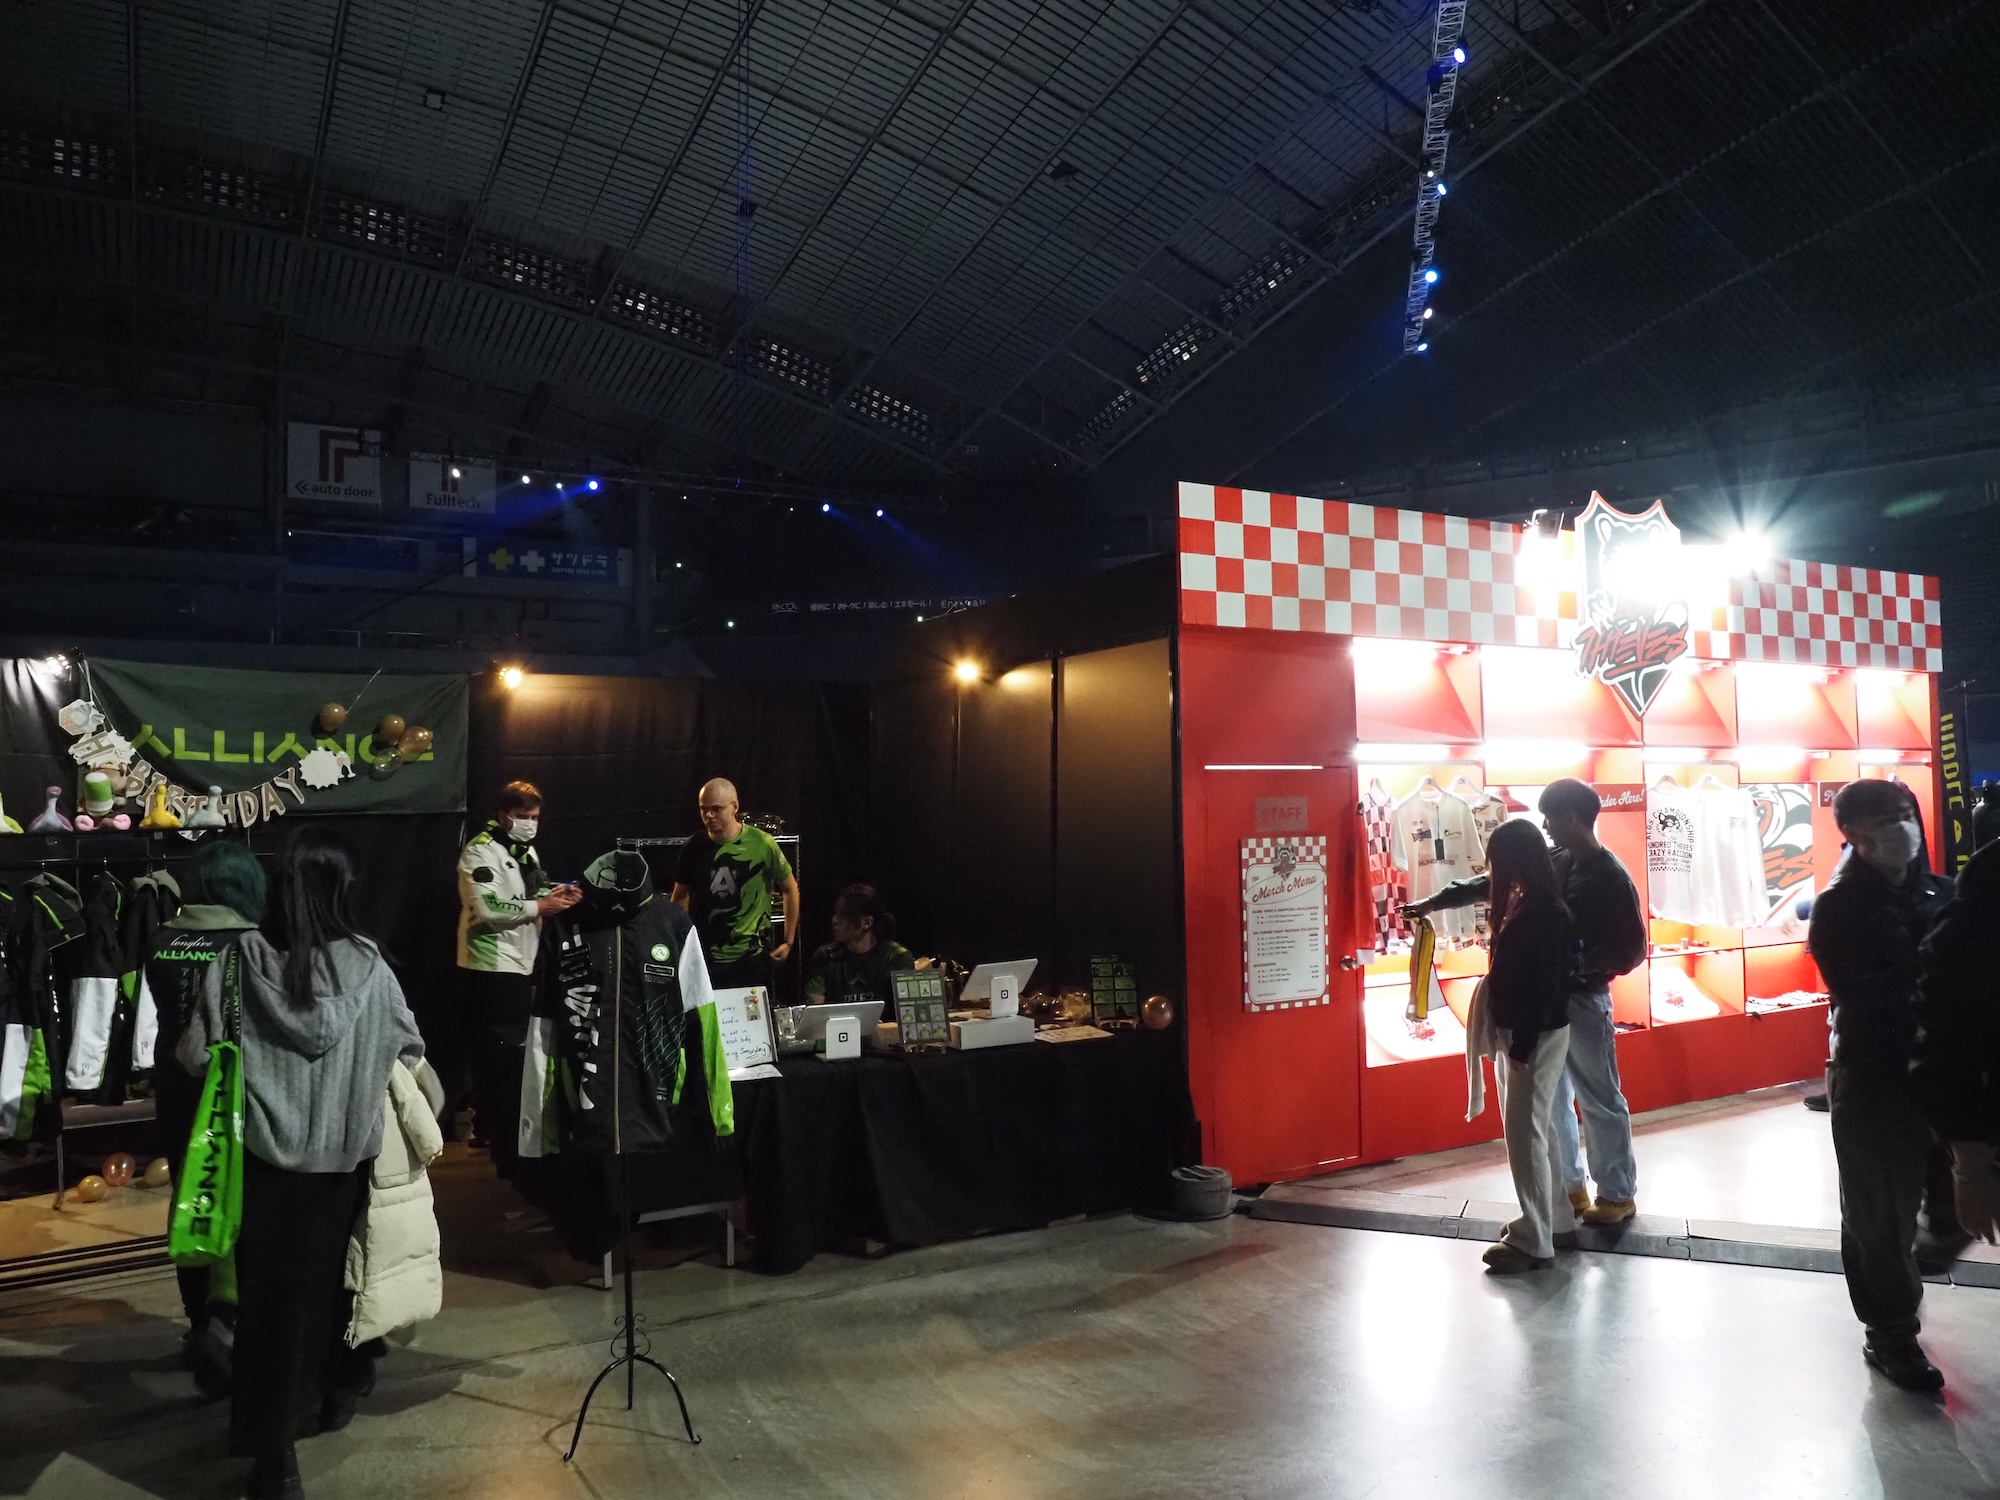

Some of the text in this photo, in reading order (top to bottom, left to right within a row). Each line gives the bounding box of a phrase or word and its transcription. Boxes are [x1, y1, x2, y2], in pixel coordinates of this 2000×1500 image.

[312, 484, 374, 497] auto door
[426, 493, 481, 509] Fulltech
[551, 551, 608, 567] サツドラ
[131, 723, 433, 765] ALLIANC
[1598, 788, 1645, 808] rder Here!
[1260, 806, 1303, 821] STAFF
[1648, 841, 1671, 849] UNDRED
[1252, 875, 1317, 903] Merch Menu
[153, 949, 221, 962] ALLIANC
